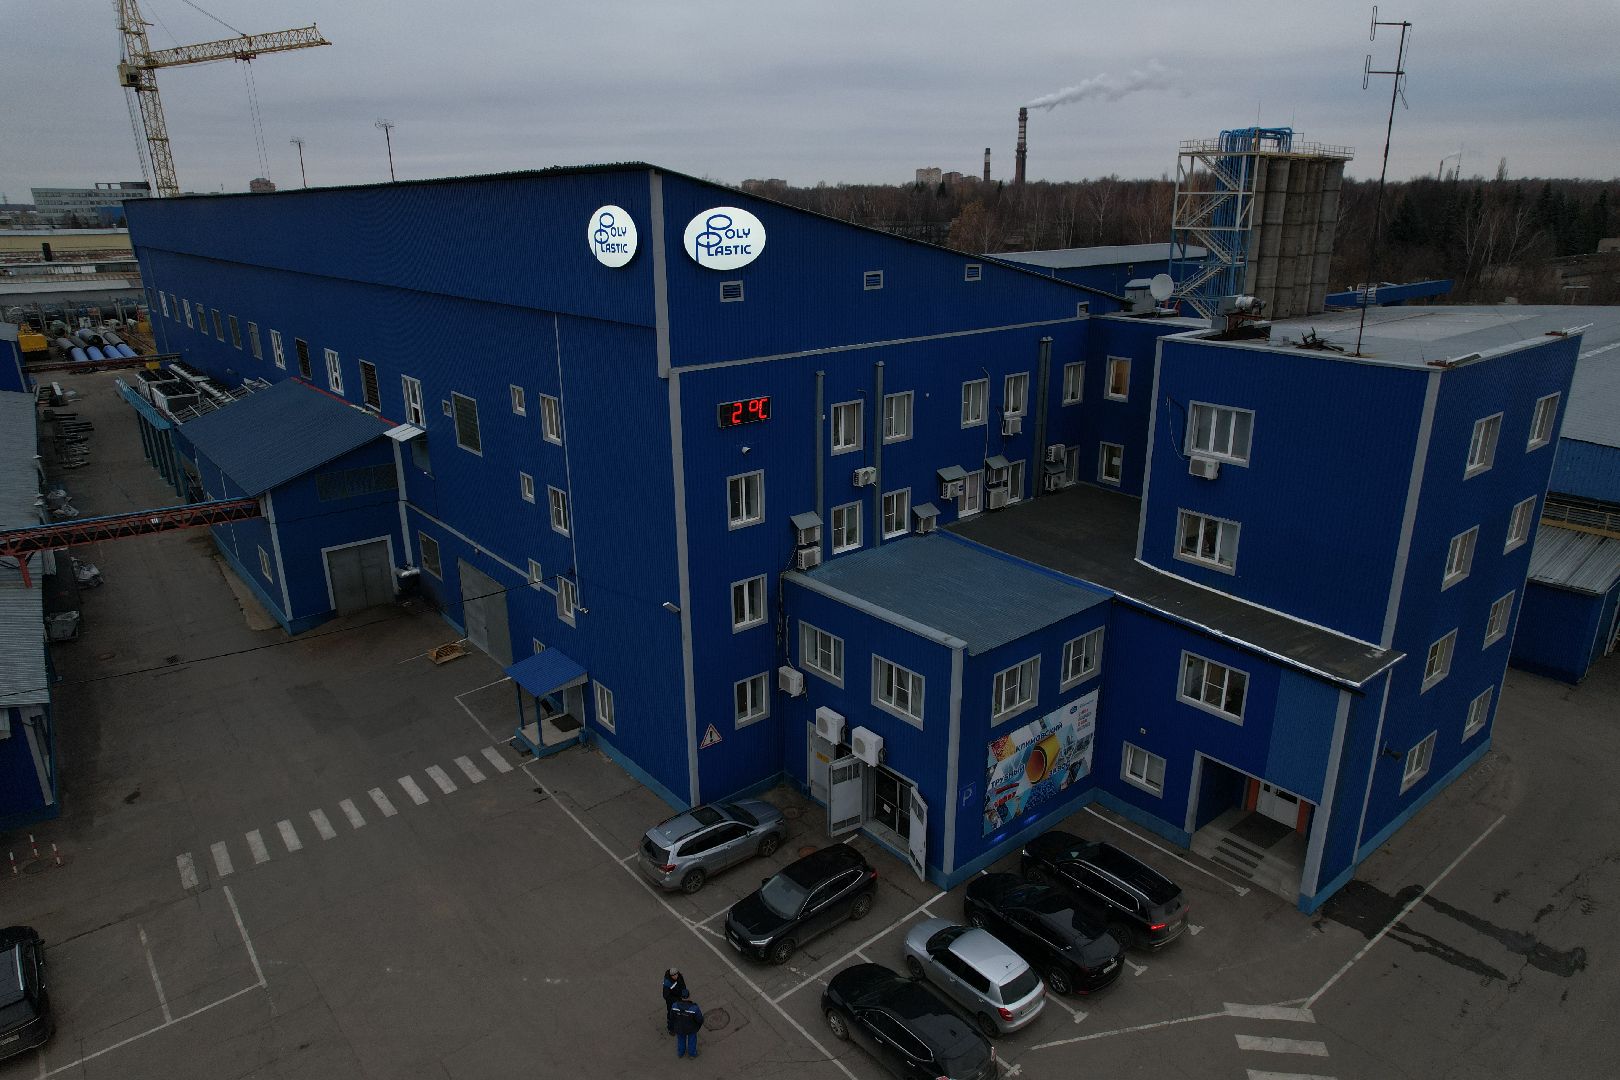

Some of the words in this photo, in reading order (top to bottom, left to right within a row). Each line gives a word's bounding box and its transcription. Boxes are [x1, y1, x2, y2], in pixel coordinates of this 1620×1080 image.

[599, 212, 627, 238] POLY
[706, 214, 751, 240] POLY
[732, 402, 743, 424] 2
[990, 763, 1025, 788] ТРУБНЫЙ
